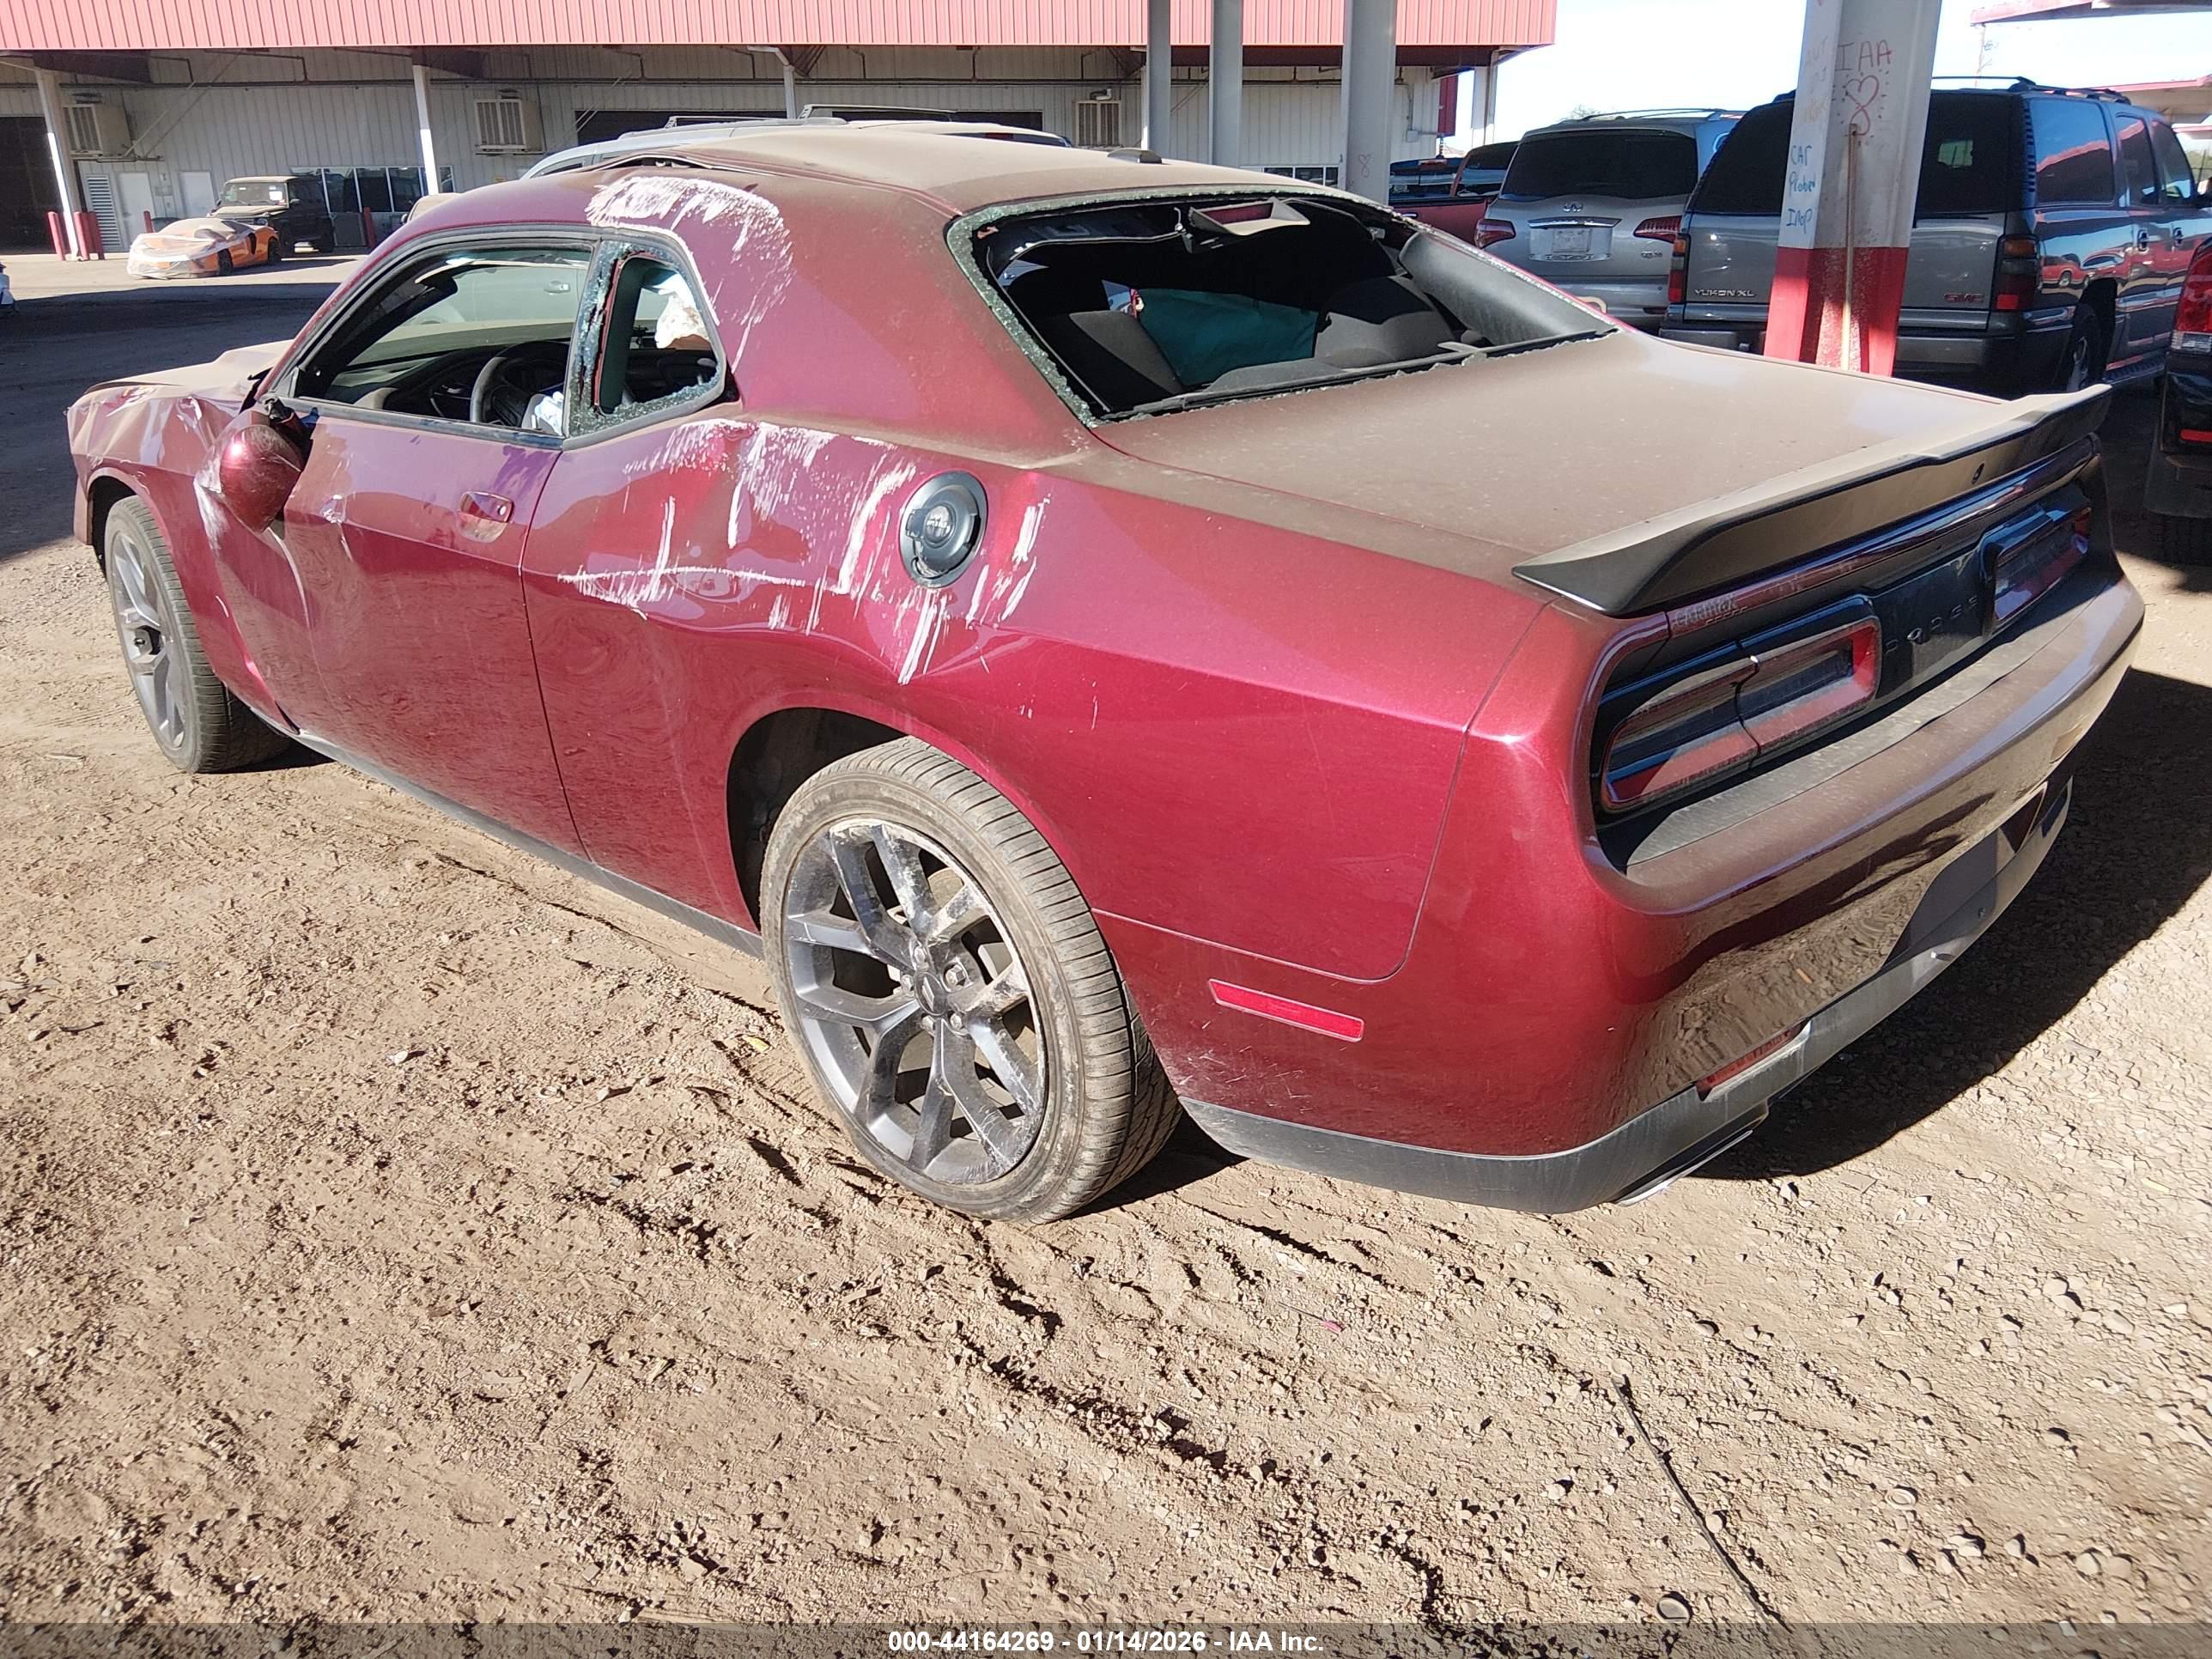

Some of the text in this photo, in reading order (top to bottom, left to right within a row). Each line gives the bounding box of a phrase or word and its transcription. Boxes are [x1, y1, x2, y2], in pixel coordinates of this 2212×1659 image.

[1834, 40, 1893, 71] IAA
[1693, 289, 1755, 297] YUKON XL
[1943, 292, 1985, 303] GMC
